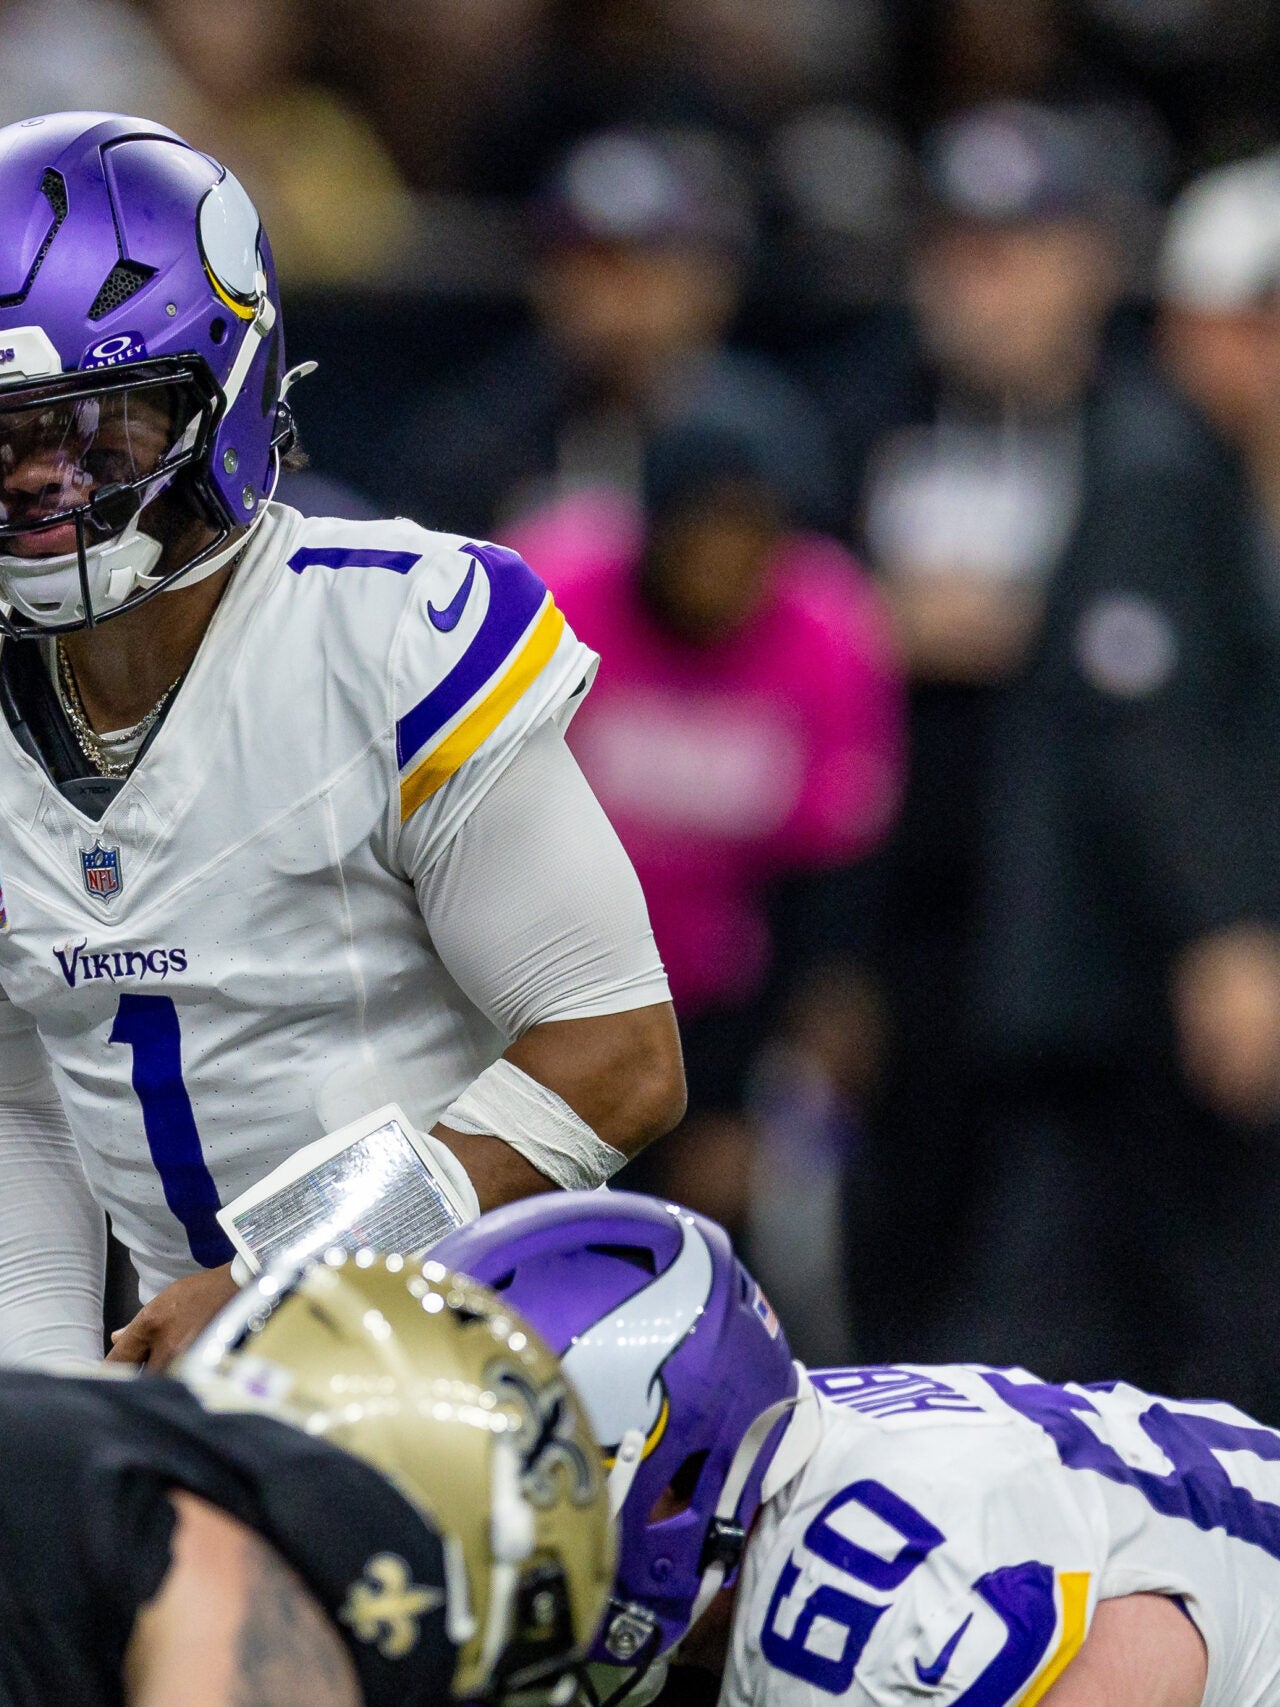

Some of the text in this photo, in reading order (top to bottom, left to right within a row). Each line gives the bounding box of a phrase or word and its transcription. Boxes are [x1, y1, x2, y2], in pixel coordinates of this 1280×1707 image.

[286, 547, 423, 575] 1
[87, 867, 117, 892] NFL
[108, 993, 238, 1270] 1
[760, 1478, 947, 1696] 60
